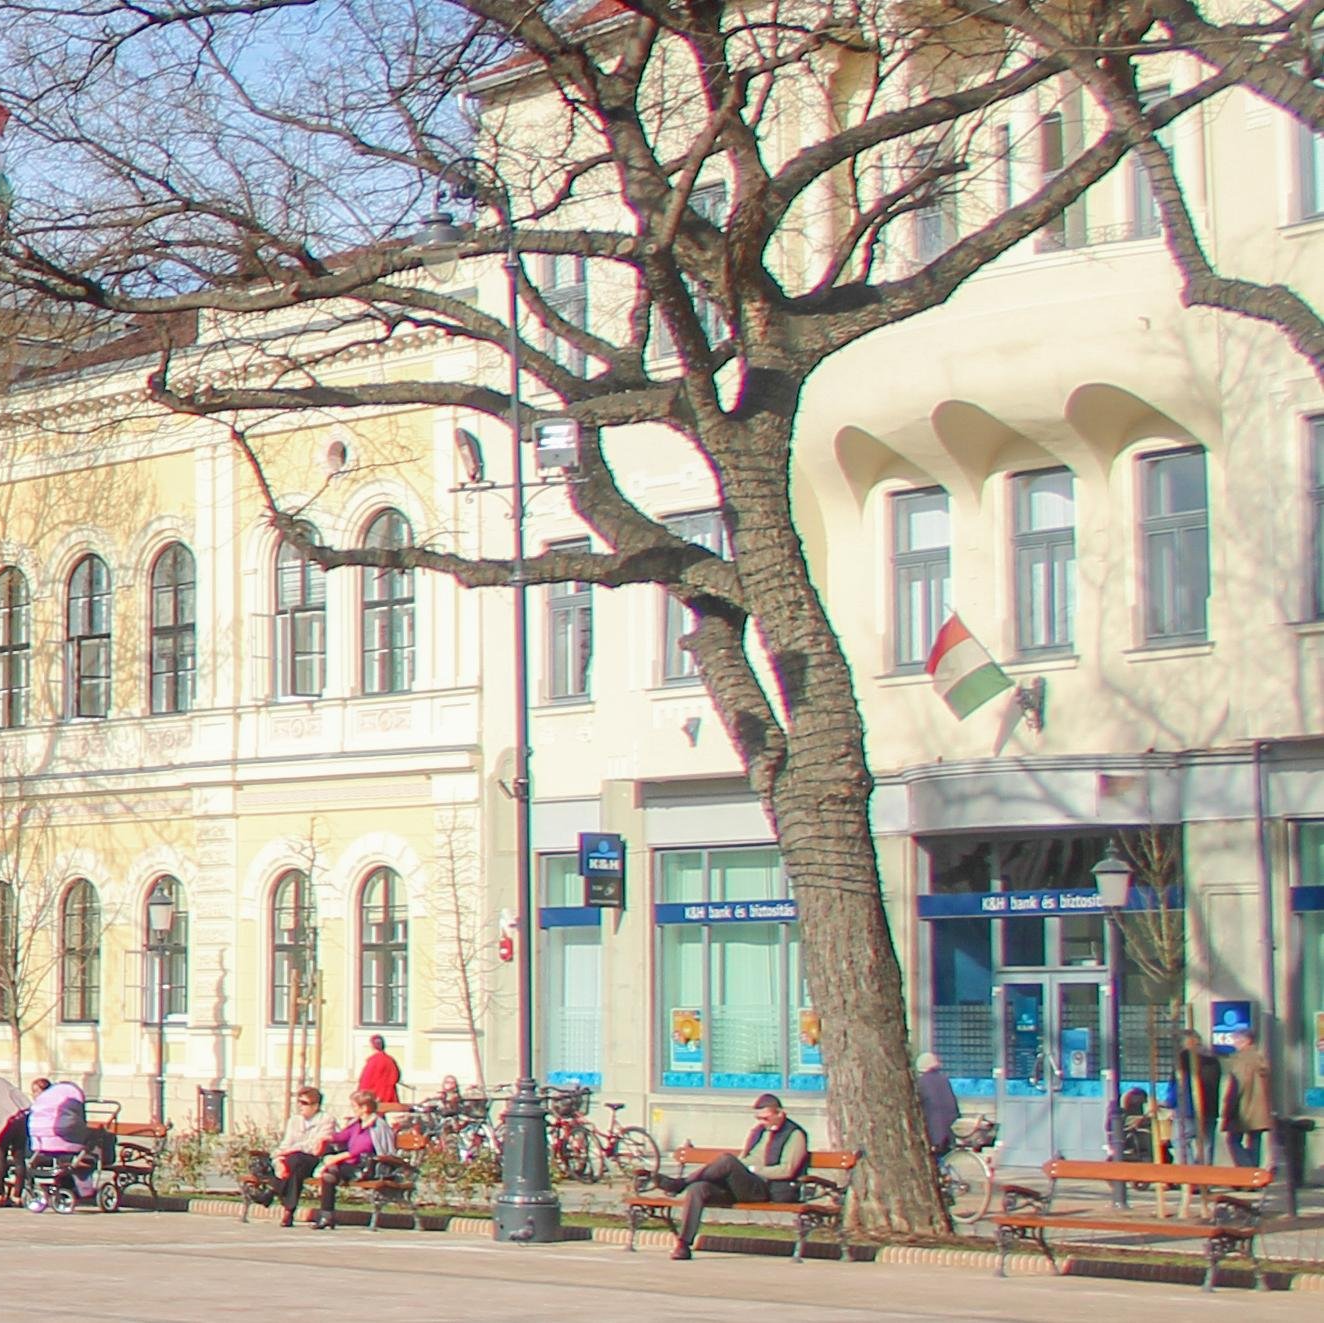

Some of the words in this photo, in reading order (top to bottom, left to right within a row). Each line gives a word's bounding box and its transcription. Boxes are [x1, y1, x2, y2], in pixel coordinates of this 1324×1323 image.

[589, 858, 621, 870] K&H
[981, 896, 1007, 911] K&H
[1010, 895, 1039, 910] bank
[1042, 894, 1057, 909] és
[1059, 893, 1103, 908] biztosít
[684, 906, 706, 919] K&H
[708, 905, 731, 918] bank
[734, 904, 747, 918] és
[749, 903, 798, 917] biztosítás
[1212, 1032, 1236, 1045] K&
